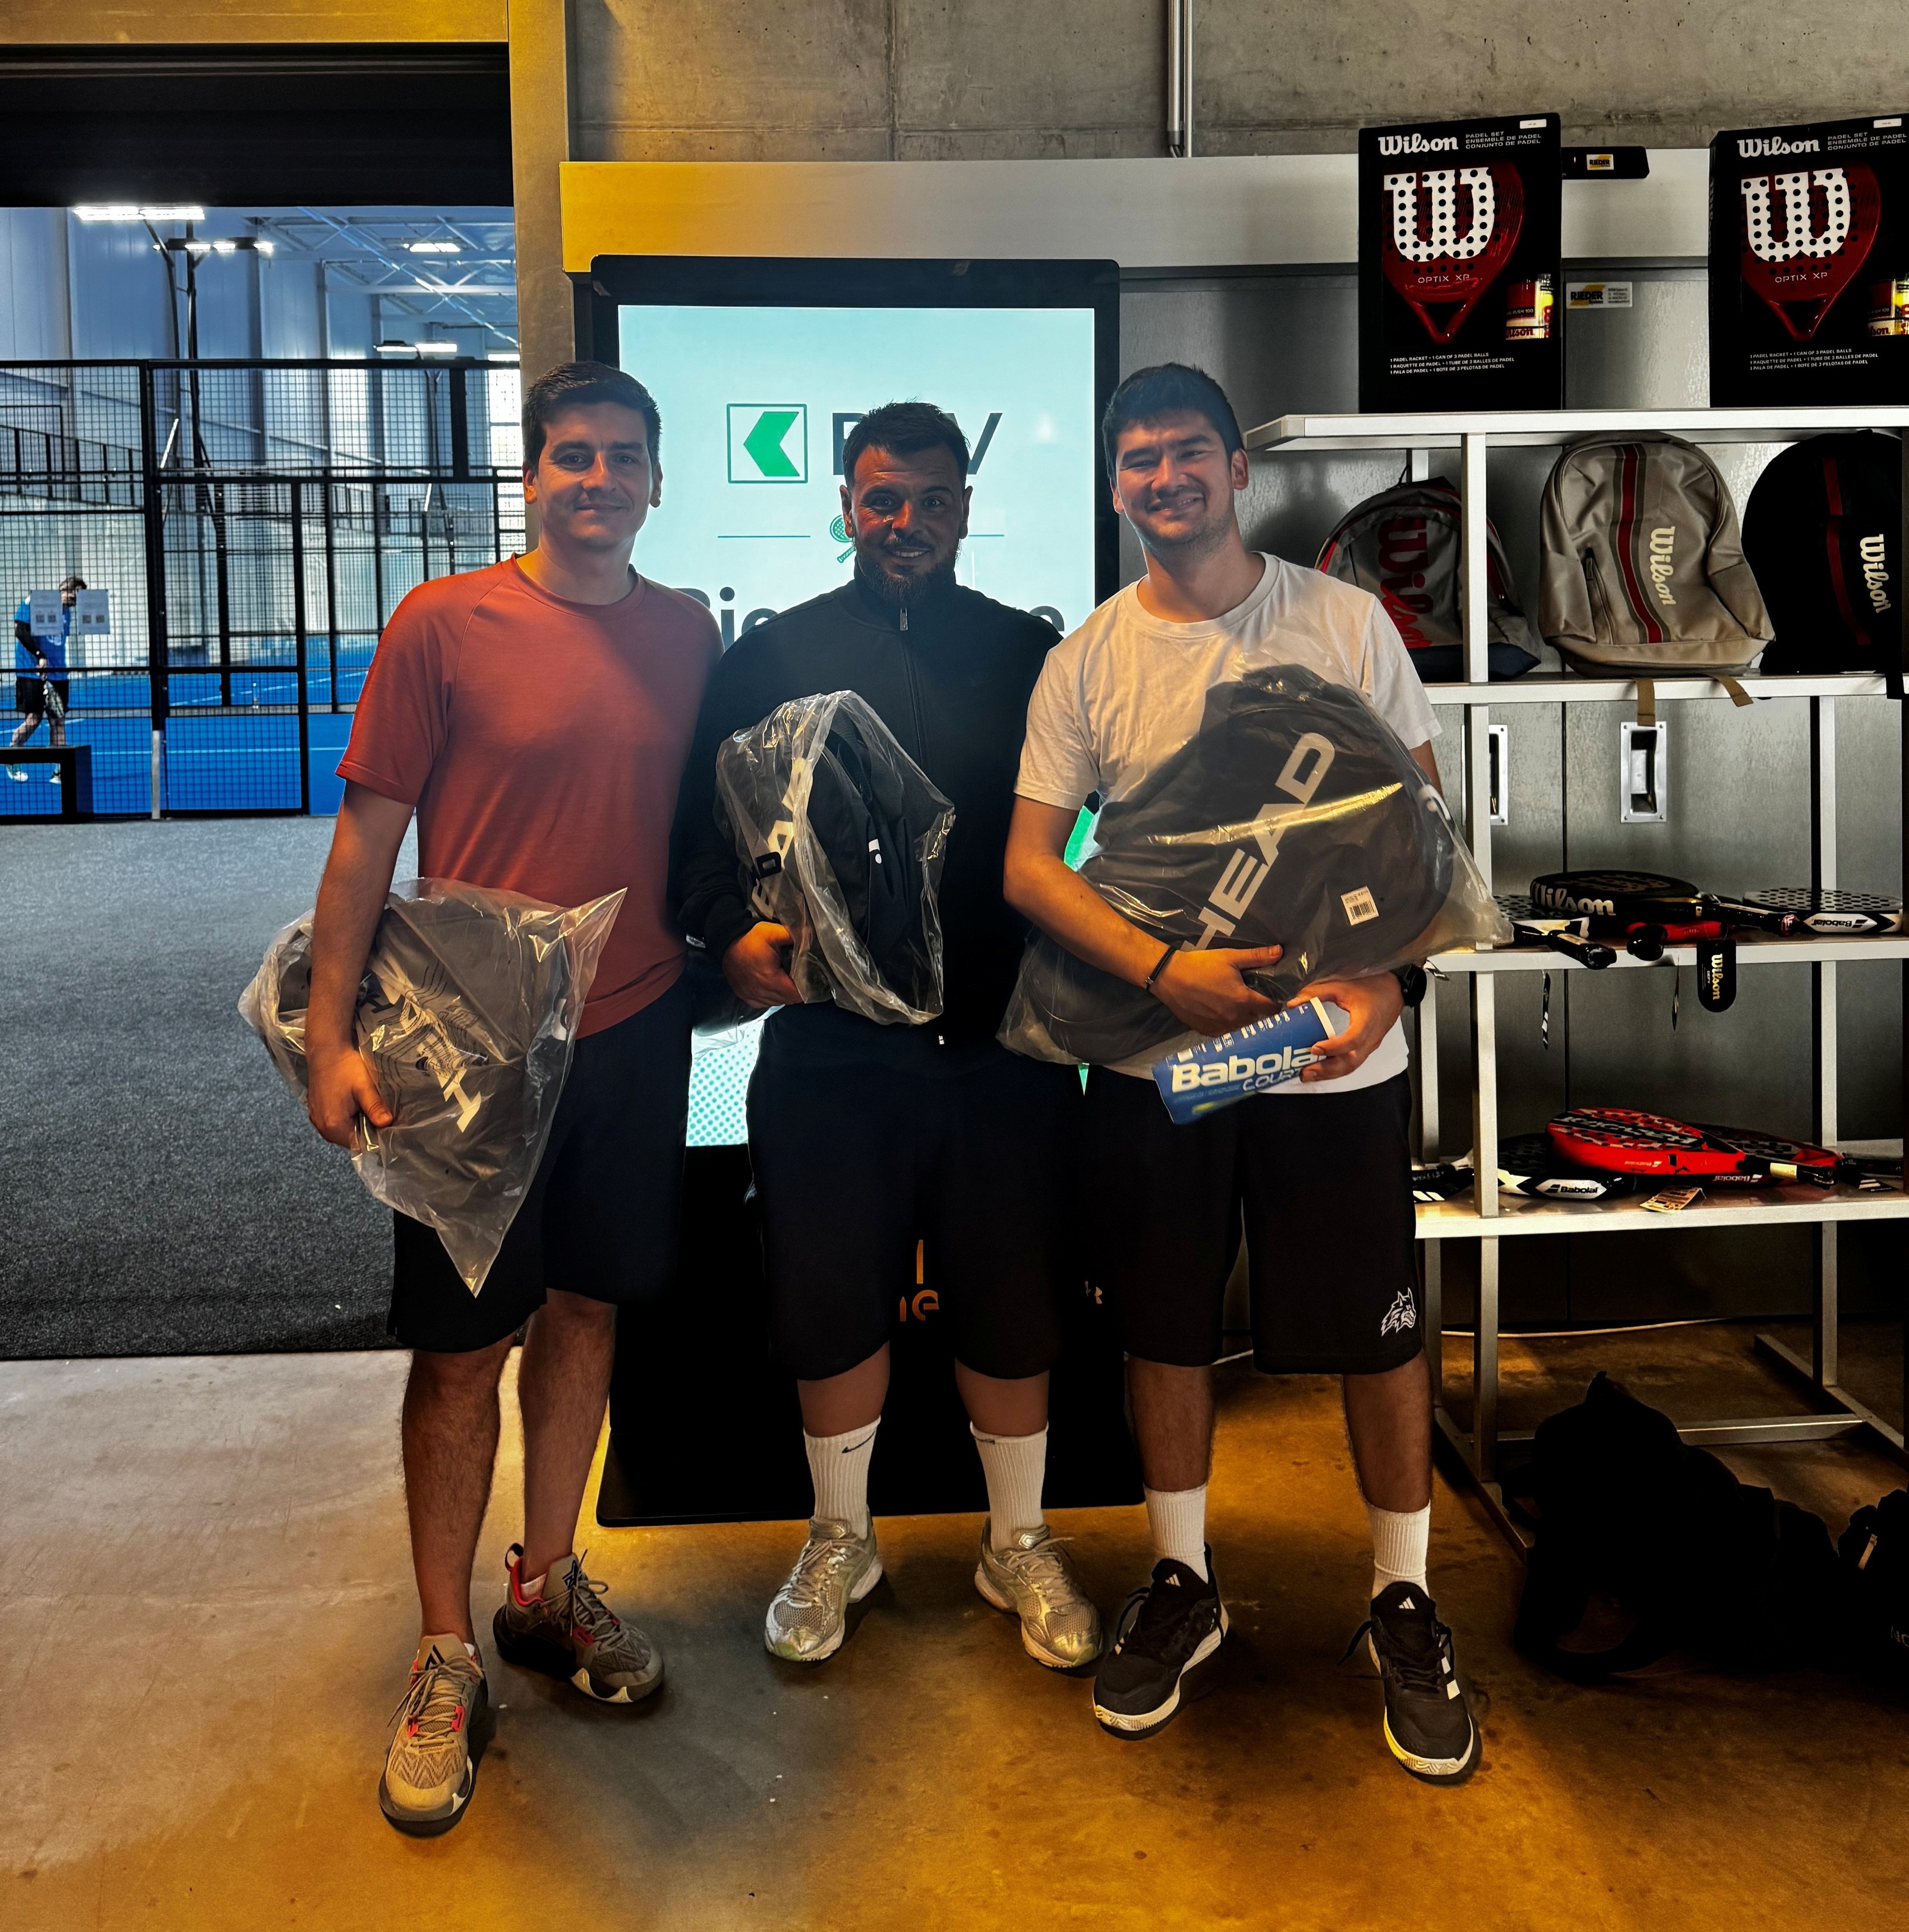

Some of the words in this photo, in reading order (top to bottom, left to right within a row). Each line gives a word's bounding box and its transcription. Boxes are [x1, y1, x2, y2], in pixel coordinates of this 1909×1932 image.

[1378, 133, 1459, 156] Wilson
[1737, 136, 1820, 158] Wilson
[1418, 275, 1449, 283] OPTIX
[1775, 274, 1807, 283] OPTIX
[1570, 291, 1603, 300] RIEDER
[1649, 526, 1677, 606] Wilson
[1859, 534, 1891, 614] Wilson
[1179, 732, 1336, 952] HEAD
[1529, 880, 1617, 916] Wilson
[1812, 918, 1853, 927] Babolat
[1711, 953, 1724, 1001] Wilson
[1172, 1046, 1327, 1093] Babola
[1560, 1186, 1599, 1194] Babolat
